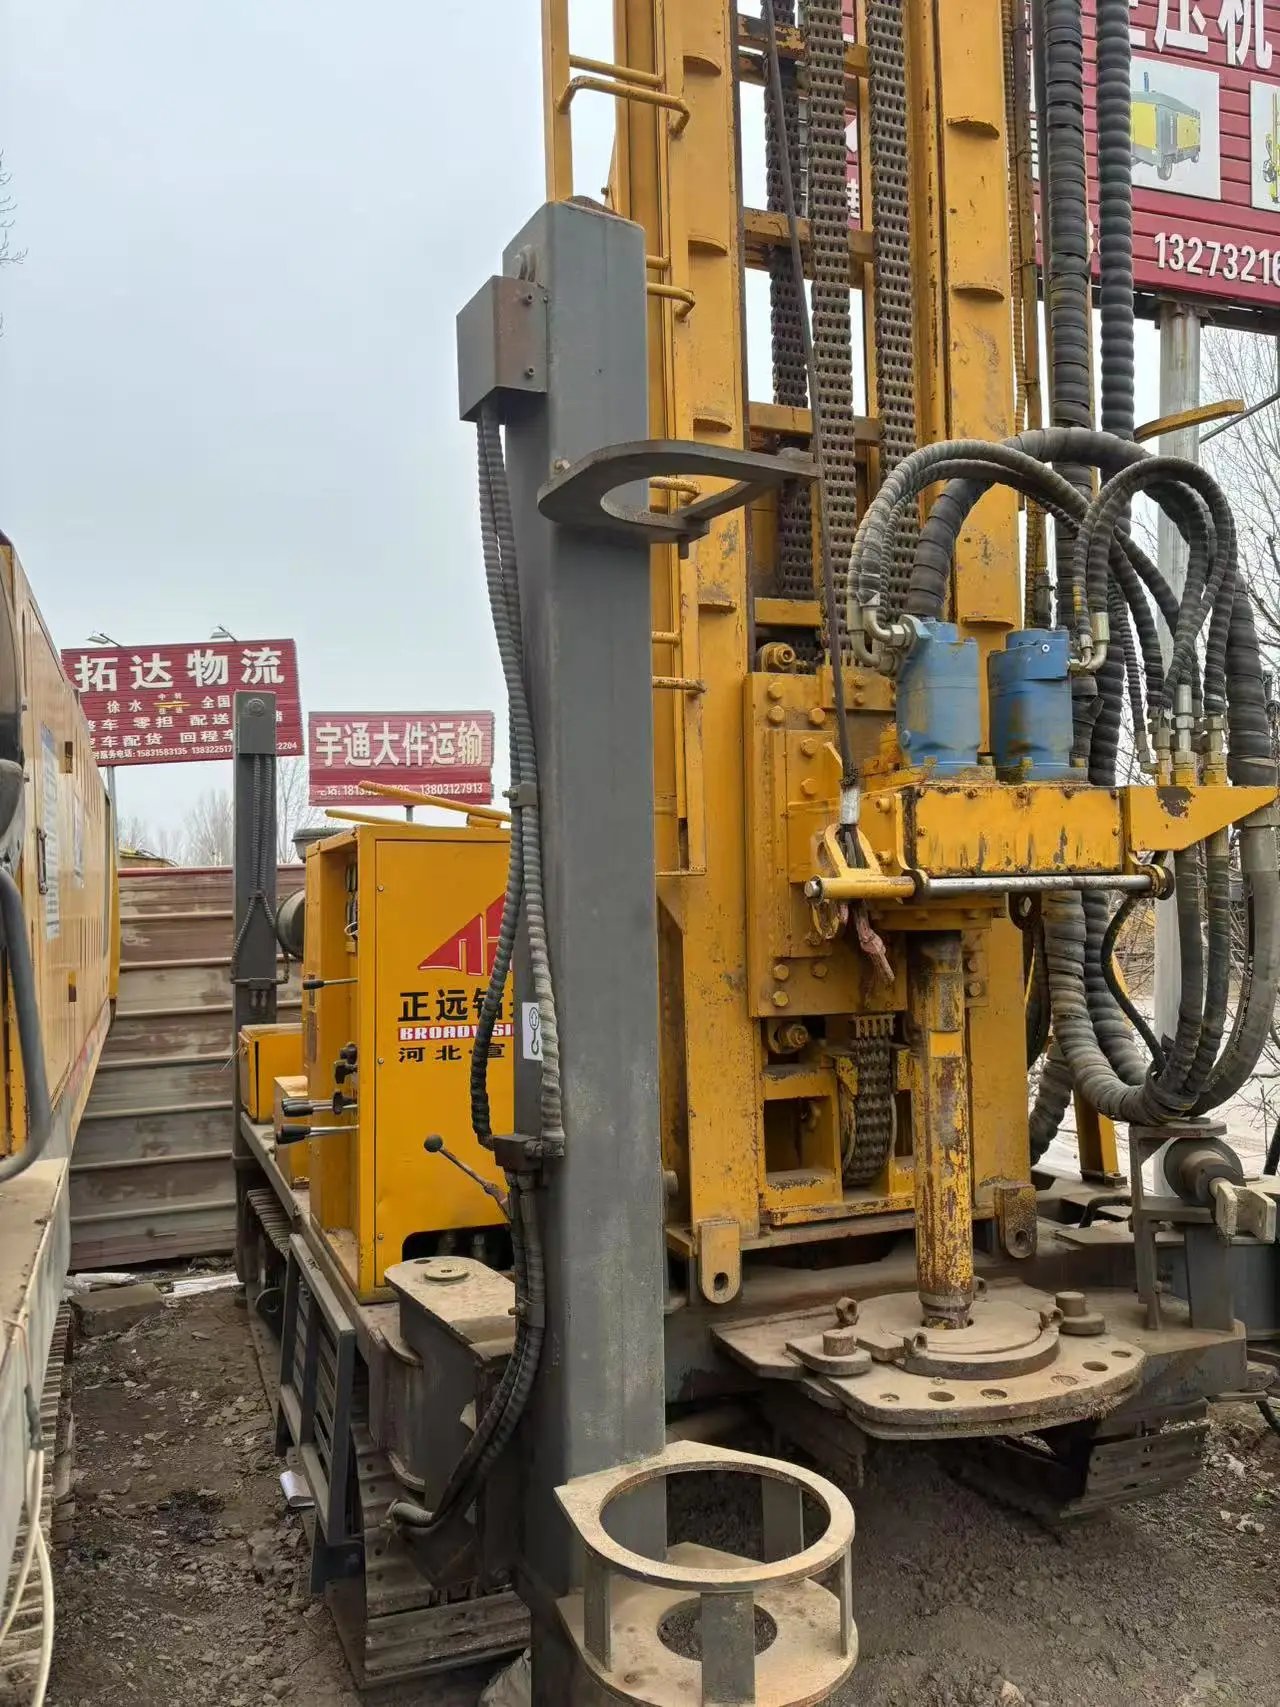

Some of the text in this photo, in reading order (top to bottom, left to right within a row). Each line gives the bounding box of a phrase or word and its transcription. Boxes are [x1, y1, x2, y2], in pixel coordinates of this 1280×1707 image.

[74, 647, 284, 692] 拓达物流
[107, 695, 231, 713] 徐水 全国
[133, 716, 174, 728] 零担
[189, 713, 229, 726] 配送
[316, 721, 484, 767] 宇通大件运输
[420, 783, 482, 795] 13803127913
